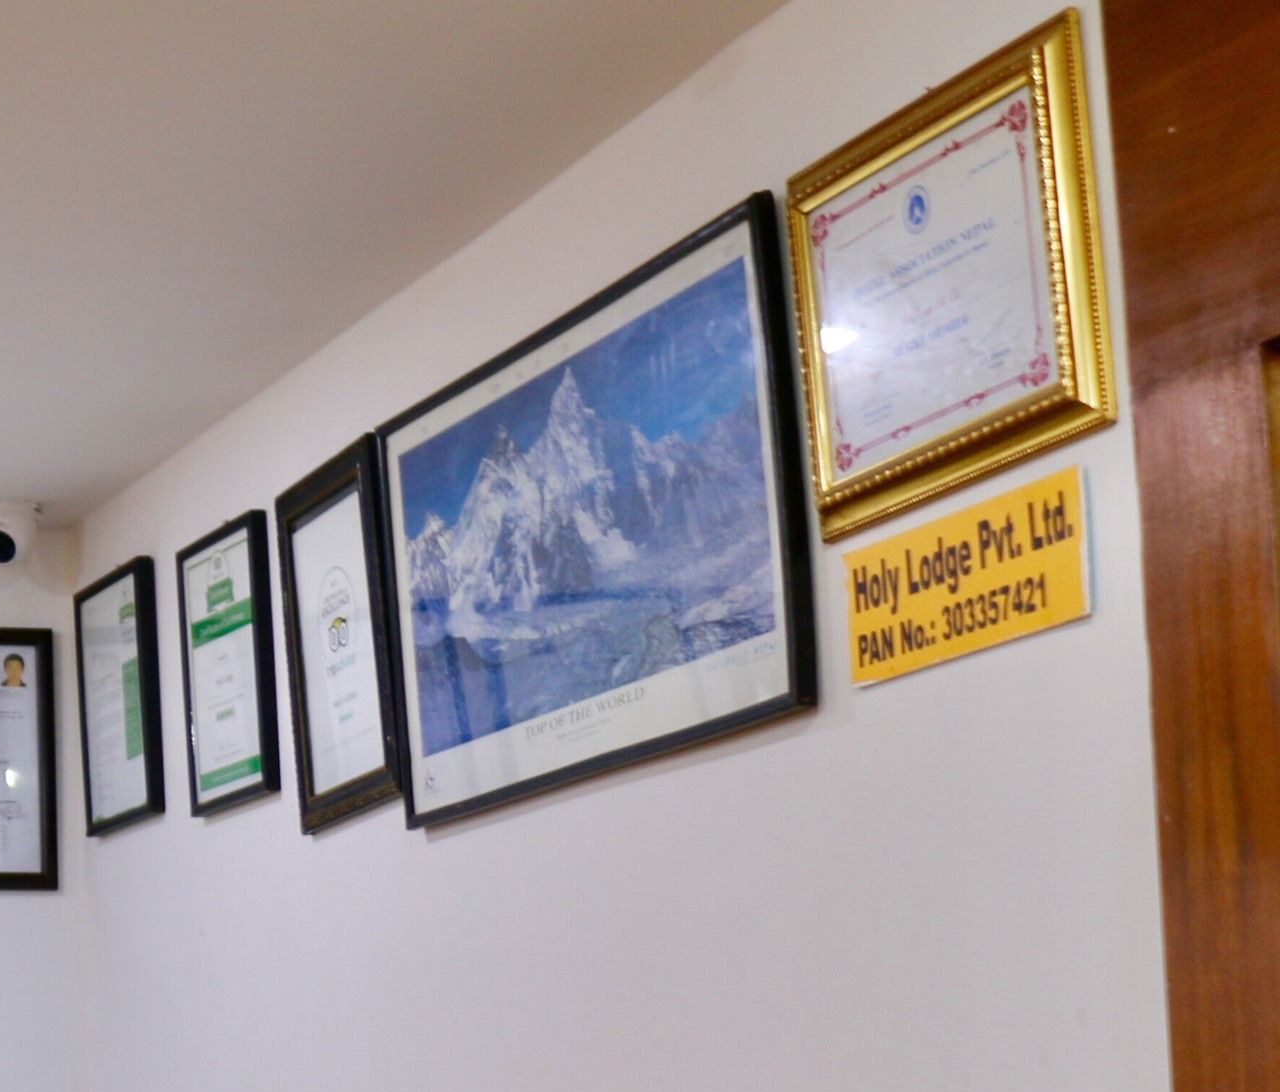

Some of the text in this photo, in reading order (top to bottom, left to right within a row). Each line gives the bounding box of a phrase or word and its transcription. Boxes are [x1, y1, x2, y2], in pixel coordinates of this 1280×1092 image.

[852, 490, 1075, 615] Holy Lodge Pvt. Ltd.
[857, 572, 1048, 668] PAN No.: 303357421
[523, 721, 548, 740] TOP
[548, 713, 566, 731] OF
[567, 703, 593, 723] THE
[594, 687, 645, 713] WORLD
